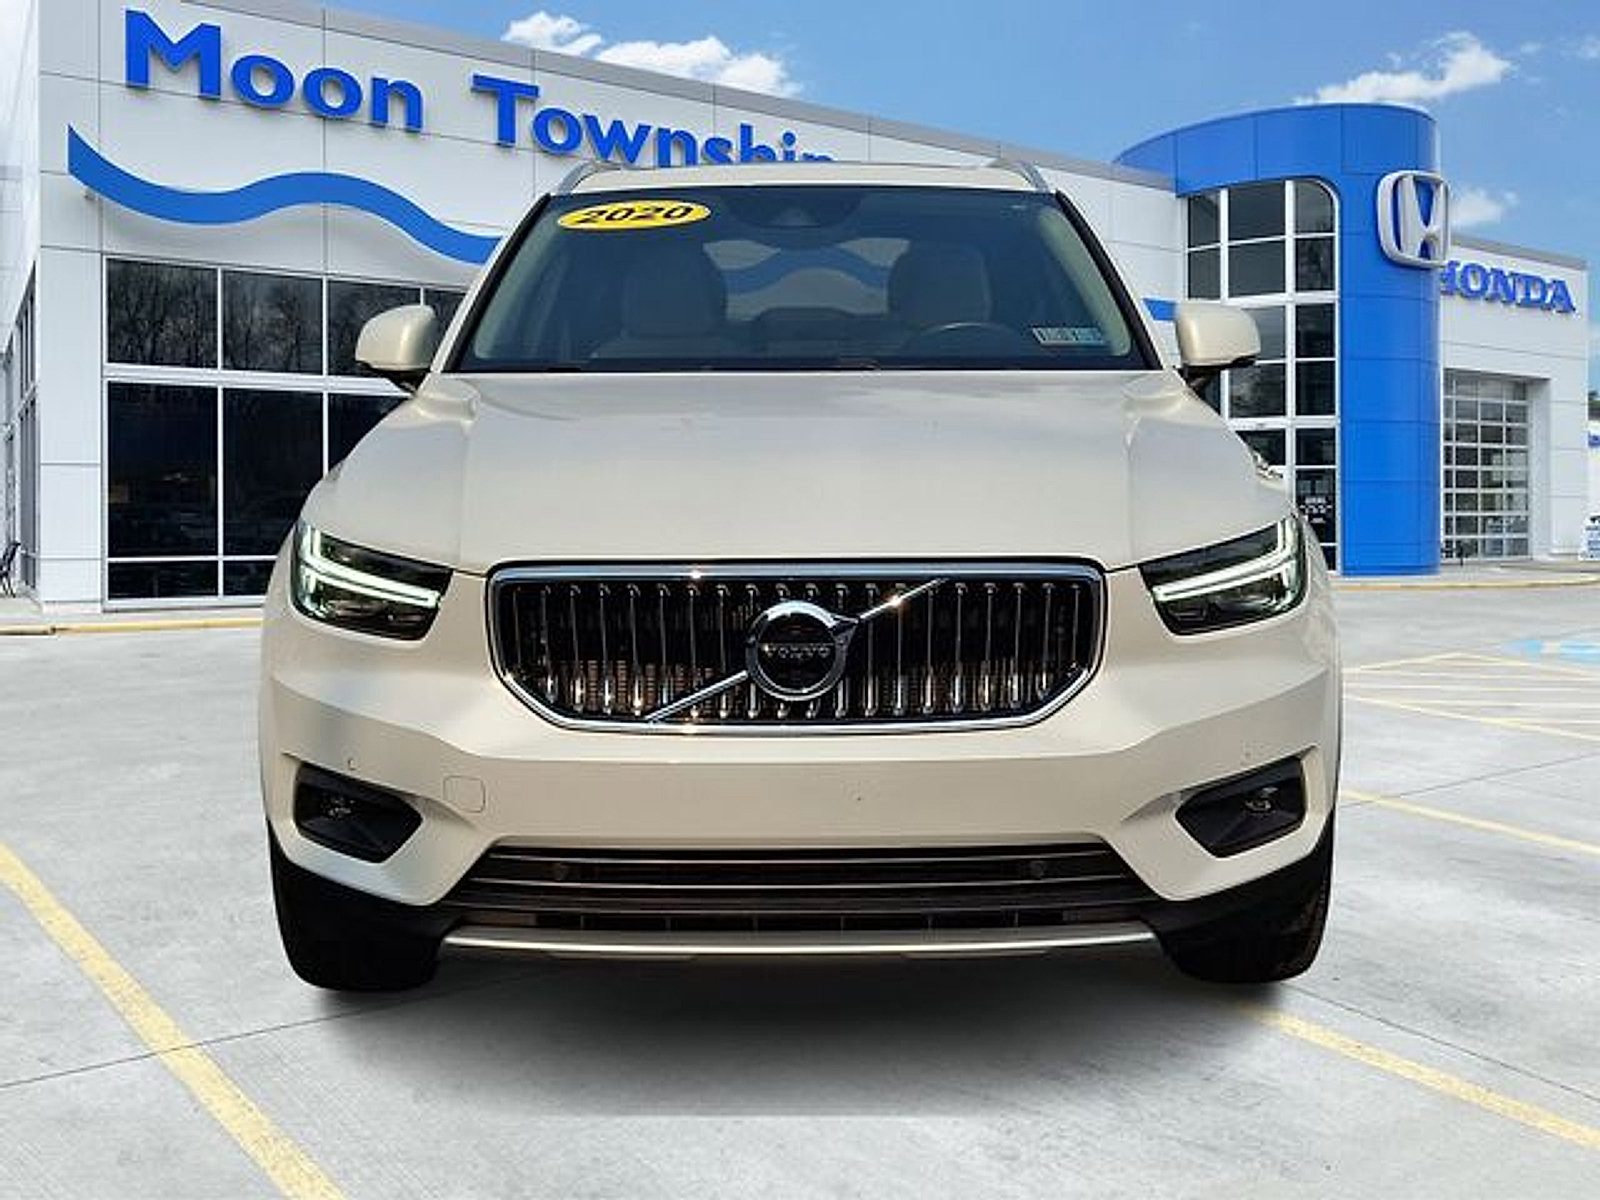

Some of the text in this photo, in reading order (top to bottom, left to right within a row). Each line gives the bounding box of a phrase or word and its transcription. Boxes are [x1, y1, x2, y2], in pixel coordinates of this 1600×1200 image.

[125, 9, 834, 168] Moon Townshi
[573, 206, 694, 225] 2020
